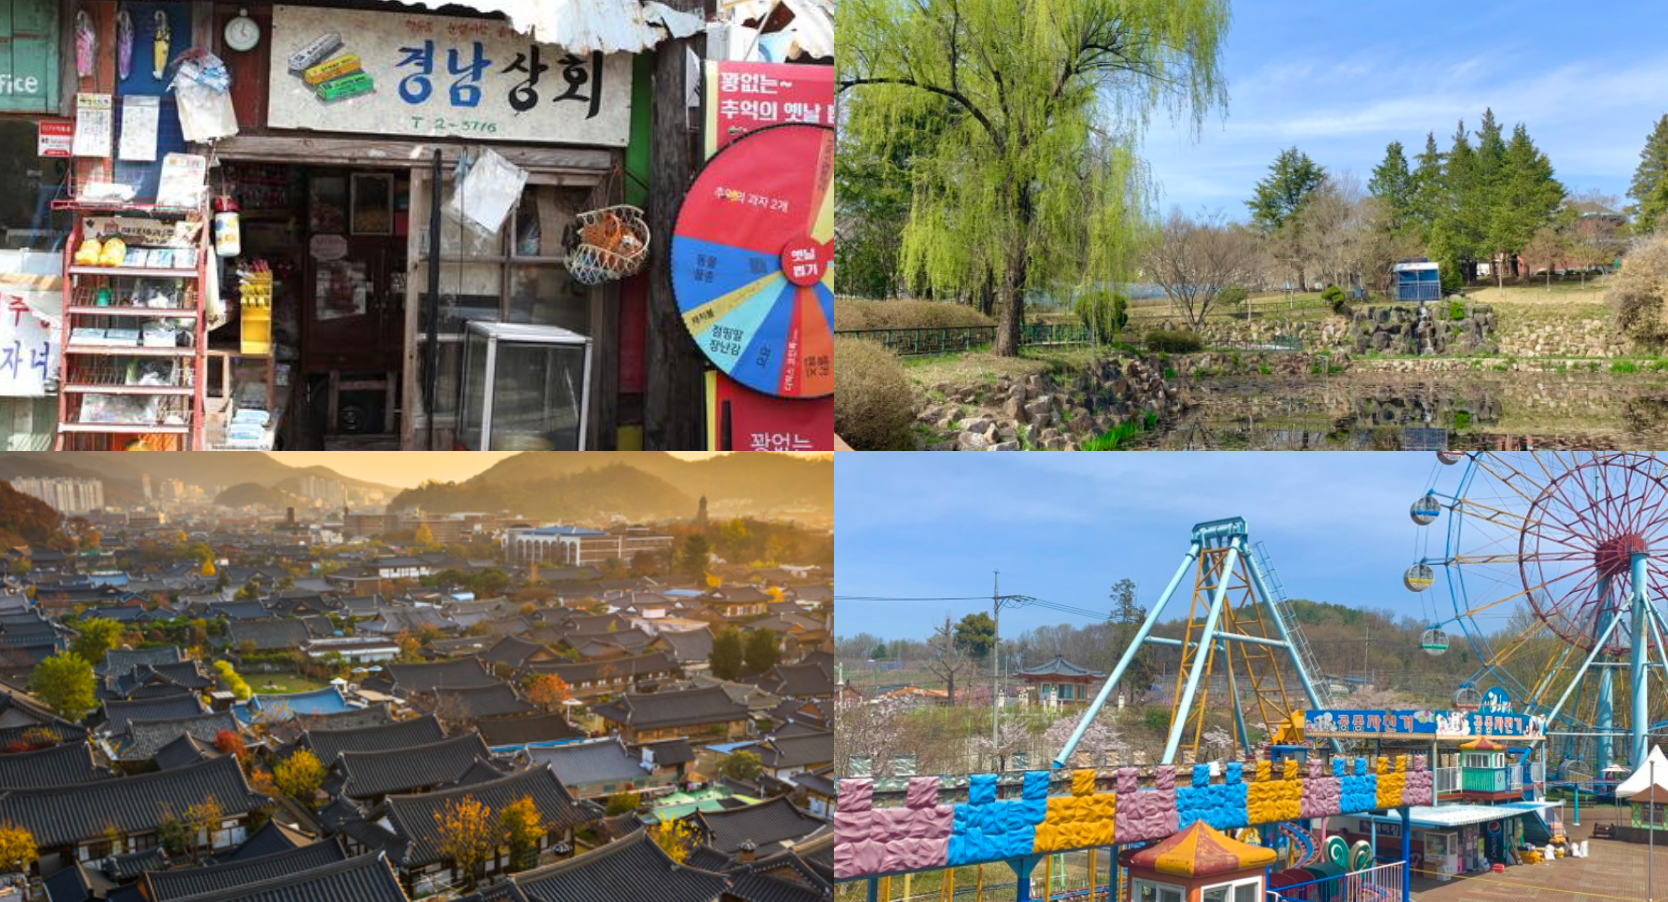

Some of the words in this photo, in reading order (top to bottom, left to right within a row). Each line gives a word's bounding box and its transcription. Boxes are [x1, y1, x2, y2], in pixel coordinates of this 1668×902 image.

[721, 100, 778, 121] 추억의
[783, 101, 821, 123] 옛날
[411, 116, 424, 129] T
[747, 194, 769, 209] 과자
[770, 200, 789, 213] 2개
[709, 339, 741, 356] 장난감
